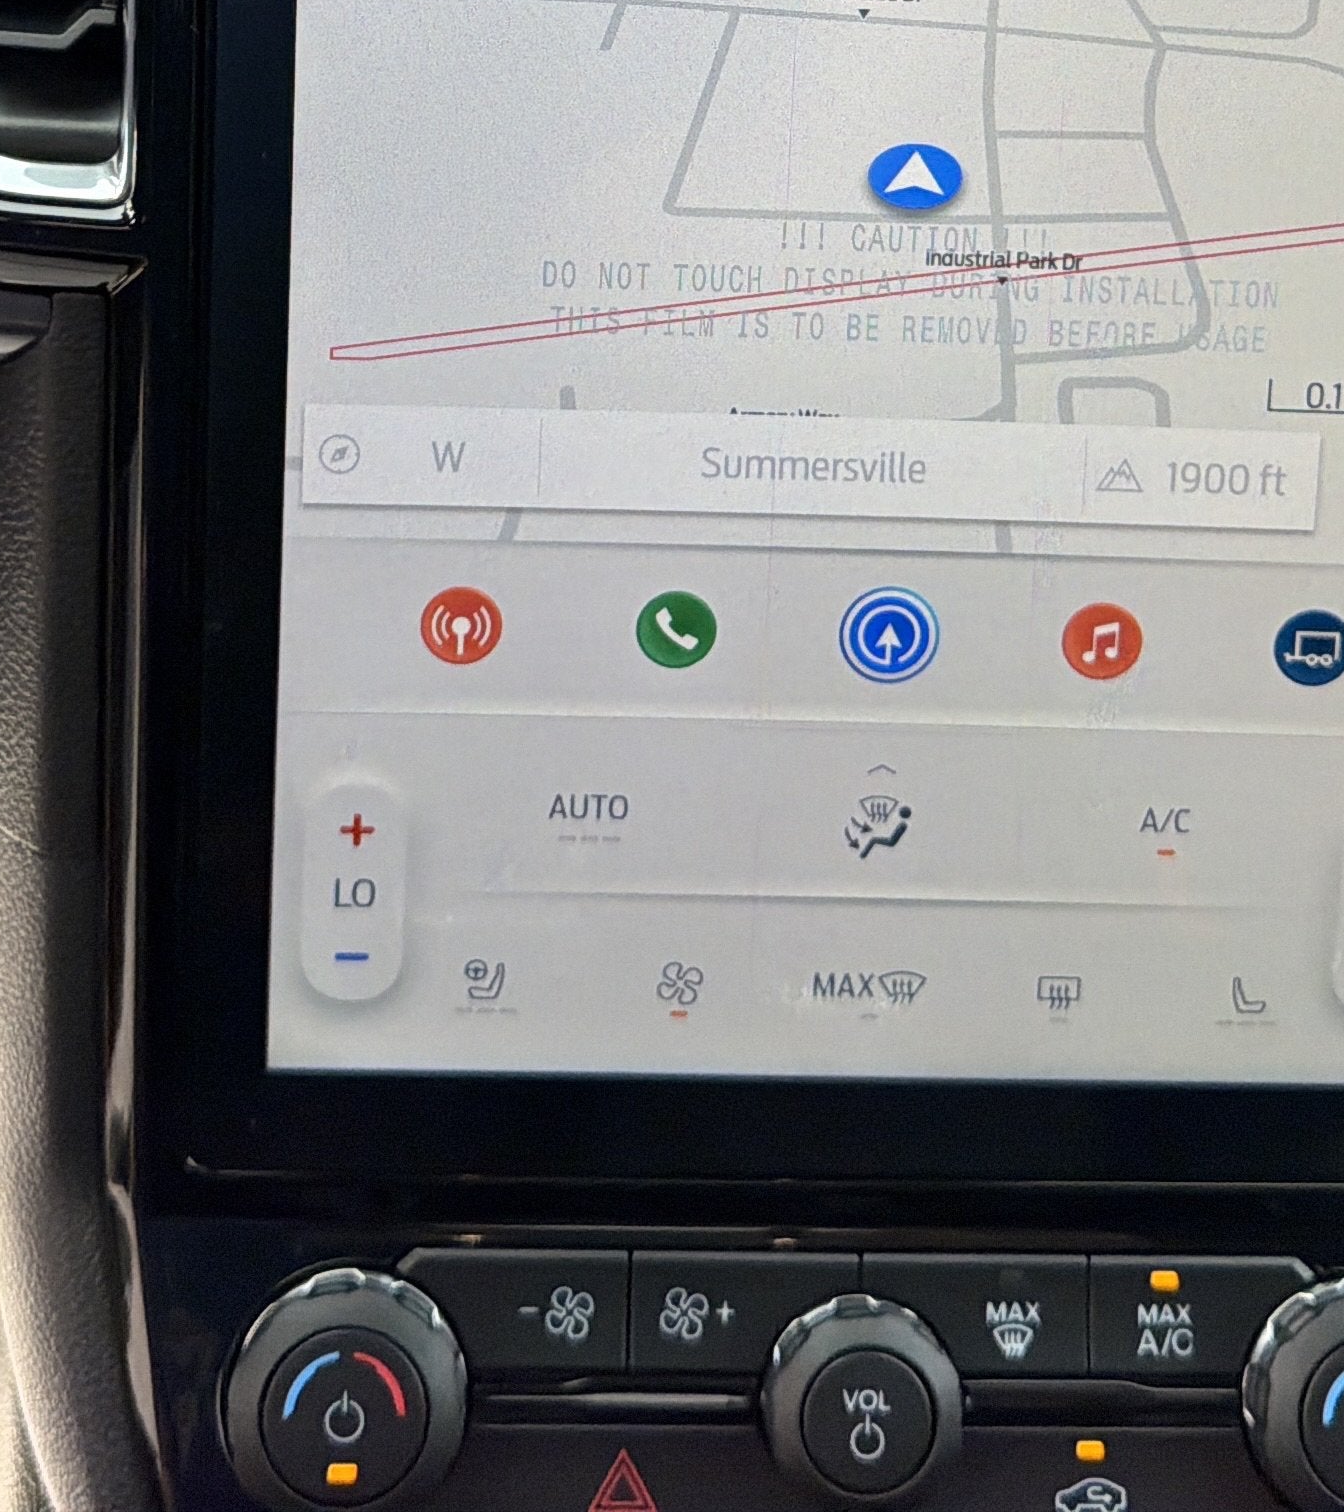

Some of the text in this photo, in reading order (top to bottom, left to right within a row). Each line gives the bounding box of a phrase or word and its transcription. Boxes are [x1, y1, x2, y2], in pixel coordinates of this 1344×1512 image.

[925, 248, 1083, 272] Industrial Park Dr
[541, 260, 577, 289] DO
[598, 261, 651, 291] NOT
[673, 262, 763, 294] TOUCH
[846, 313, 880, 342] BE
[1306, 382, 1342, 410] 0.1
[432, 440, 465, 474] W
[700, 445, 928, 484] Summersville
[1166, 460, 1288, 498] 1900 ft
[548, 792, 630, 822] AUTO
[1140, 805, 1192, 835] A/C
[332, 877, 377, 909] LO
[812, 971, 876, 1001] MAX
[985, 1300, 1041, 1325] MAX
[1136, 1302, 1193, 1326] MAX
[1136, 1326, 1195, 1357] A/C
[841, 1386, 892, 1414] VOL
